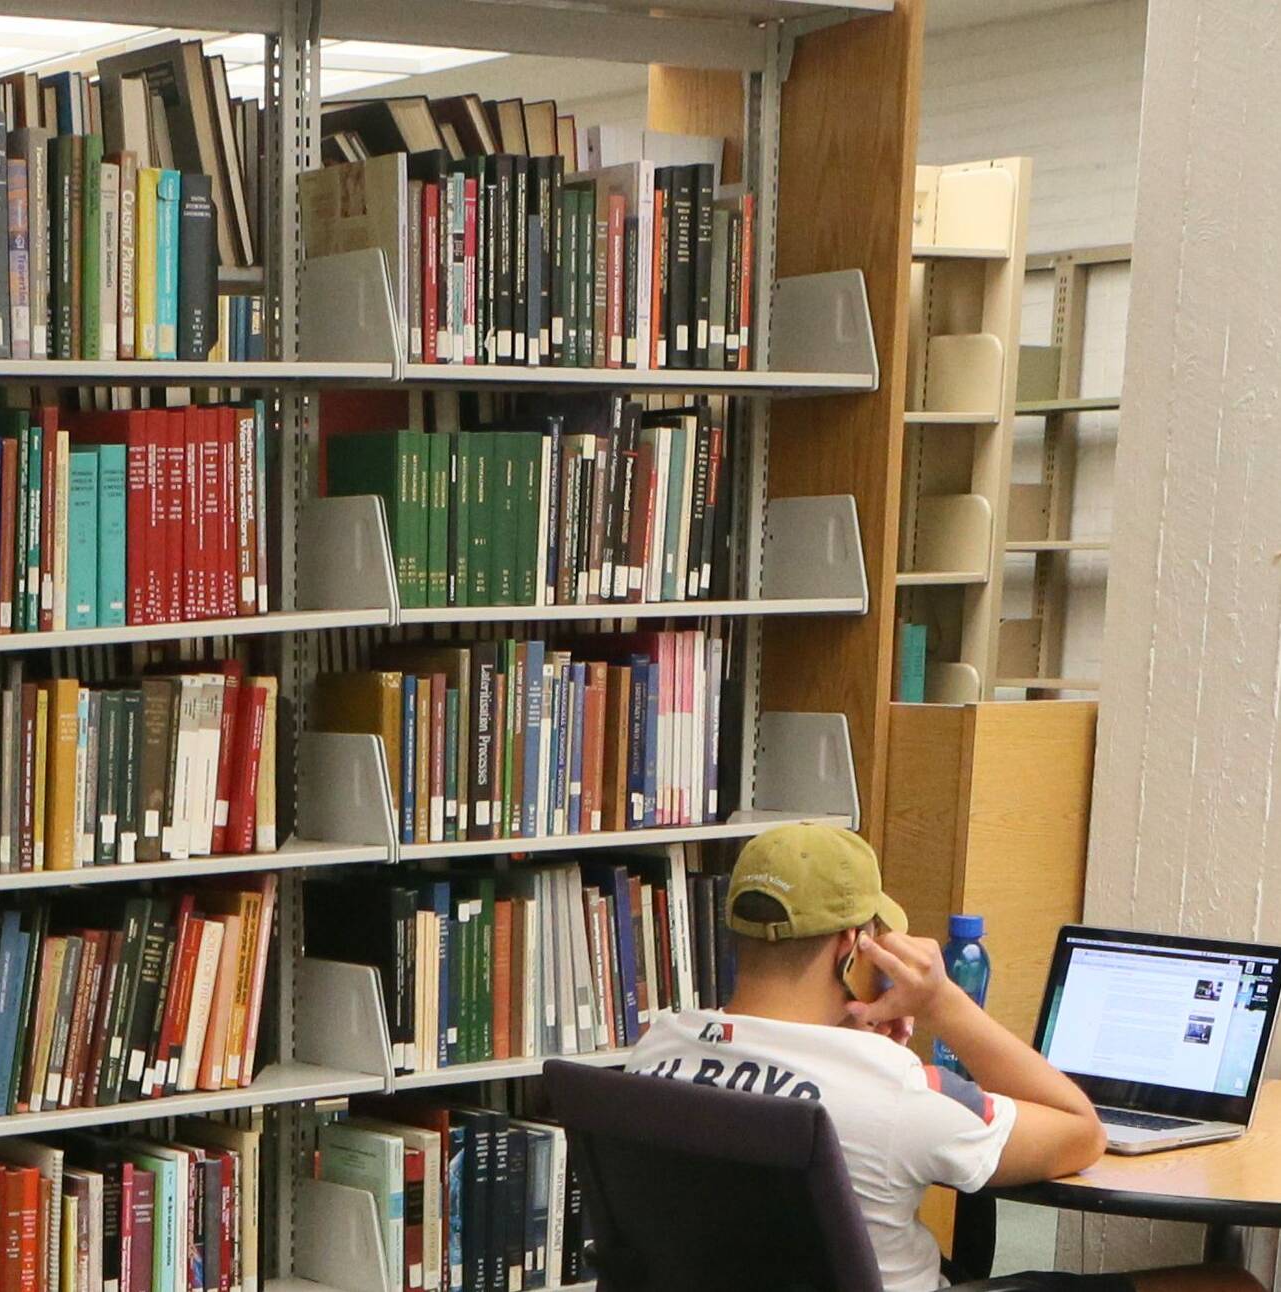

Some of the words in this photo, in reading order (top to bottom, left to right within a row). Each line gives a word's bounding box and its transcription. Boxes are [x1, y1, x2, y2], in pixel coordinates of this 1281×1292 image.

[122, 190, 134, 240] CLASTIC
[121, 243, 135, 315] PARTICLES
[239, 419, 248, 461] Water
[245, 418, 254, 489] Sediments
[246, 493, 255, 519] and
[480, 664, 493, 732] Lateritisation
[478, 735, 490, 785] Processes
